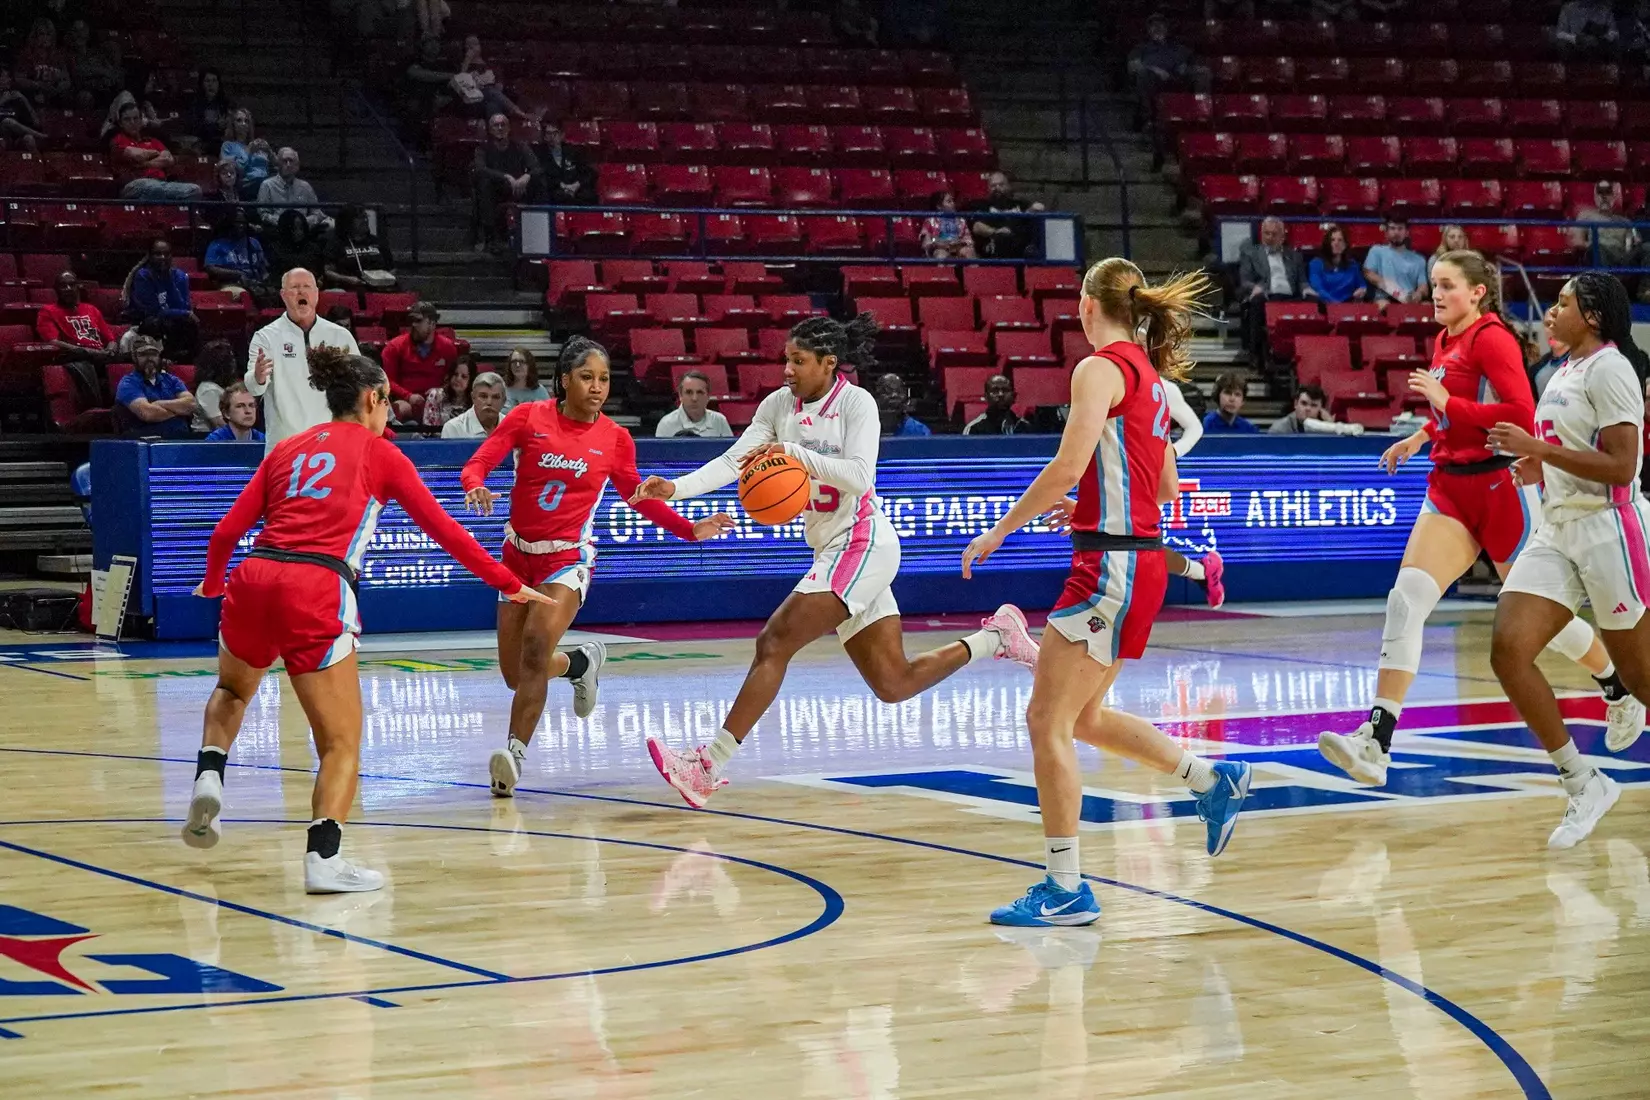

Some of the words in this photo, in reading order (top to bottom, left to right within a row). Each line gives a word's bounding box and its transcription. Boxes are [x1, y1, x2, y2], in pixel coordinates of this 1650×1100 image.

[286, 452, 336, 500] 12
[538, 452, 588, 478] Liberty
[742, 456, 788, 485] Wilson
[537, 480, 566, 512] 0
[924, 496, 1072, 535] PART
[1246, 488, 1397, 526] ATHLETICS
